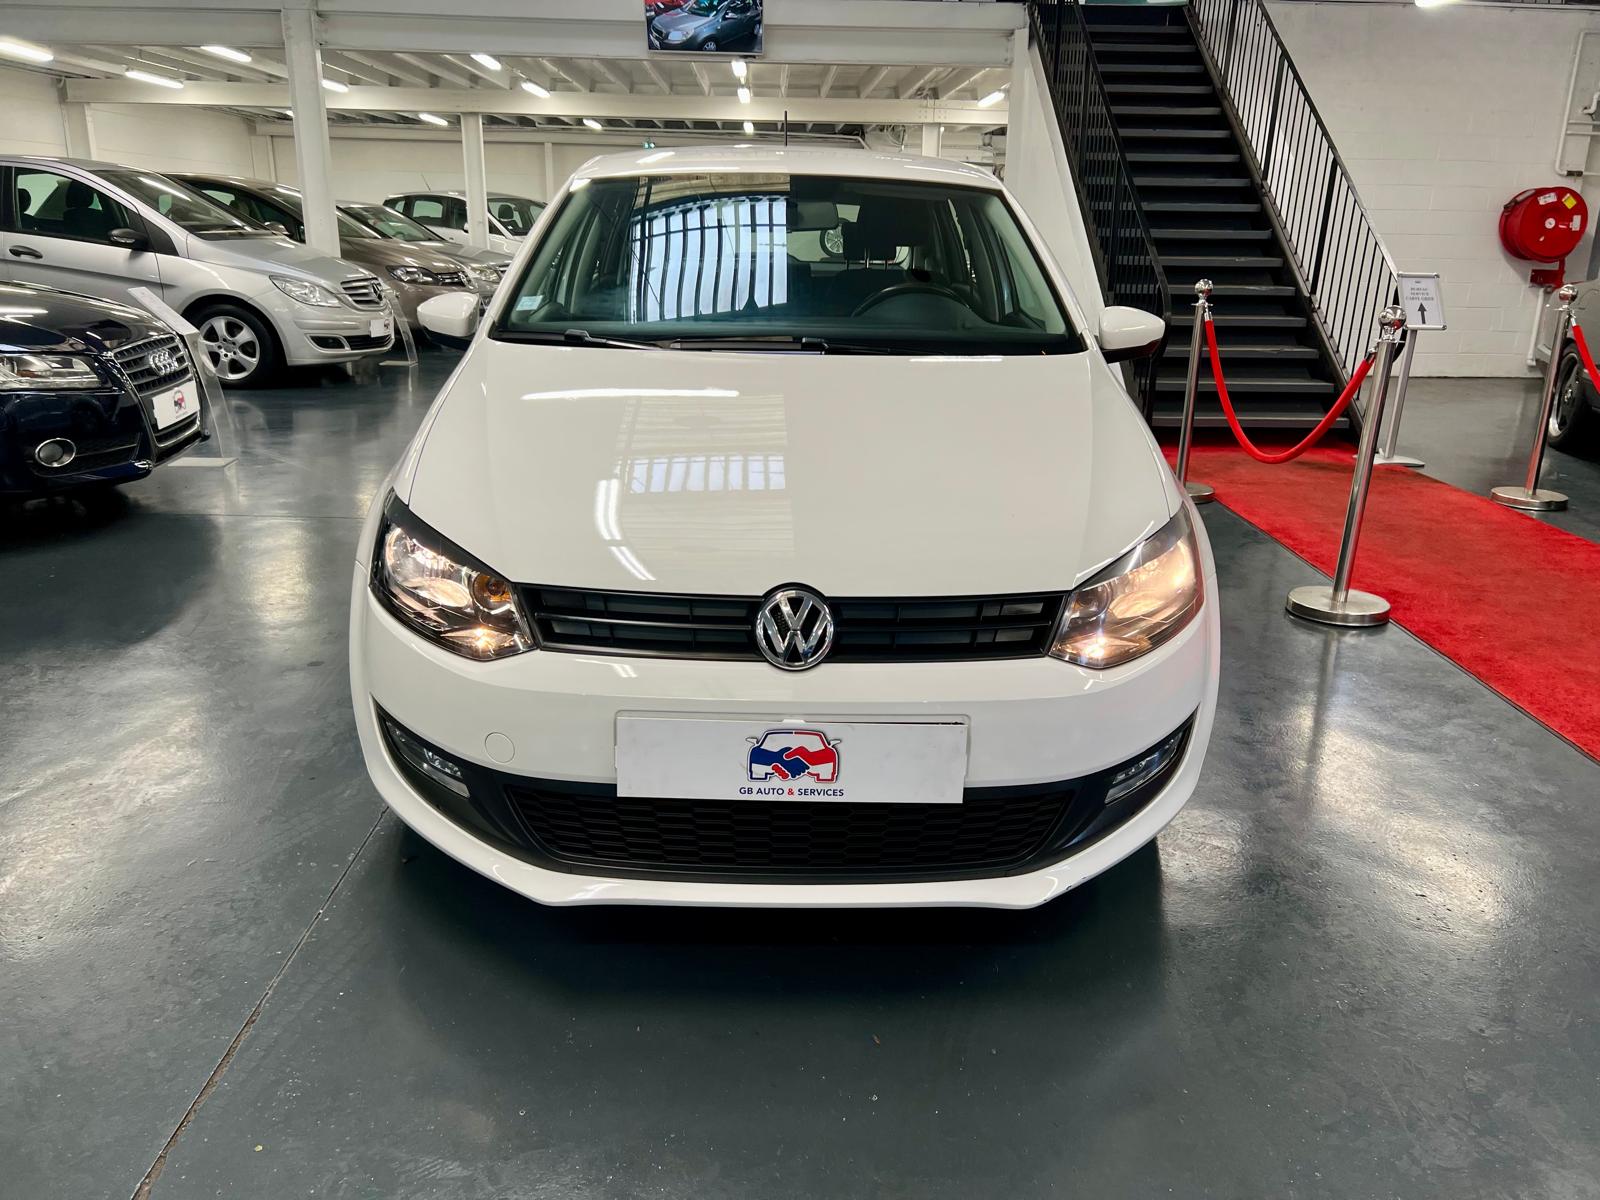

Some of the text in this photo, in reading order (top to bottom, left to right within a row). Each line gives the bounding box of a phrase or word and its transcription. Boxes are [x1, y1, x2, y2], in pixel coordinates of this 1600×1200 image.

[739, 786, 844, 797] GB AUTO & SERVICES
